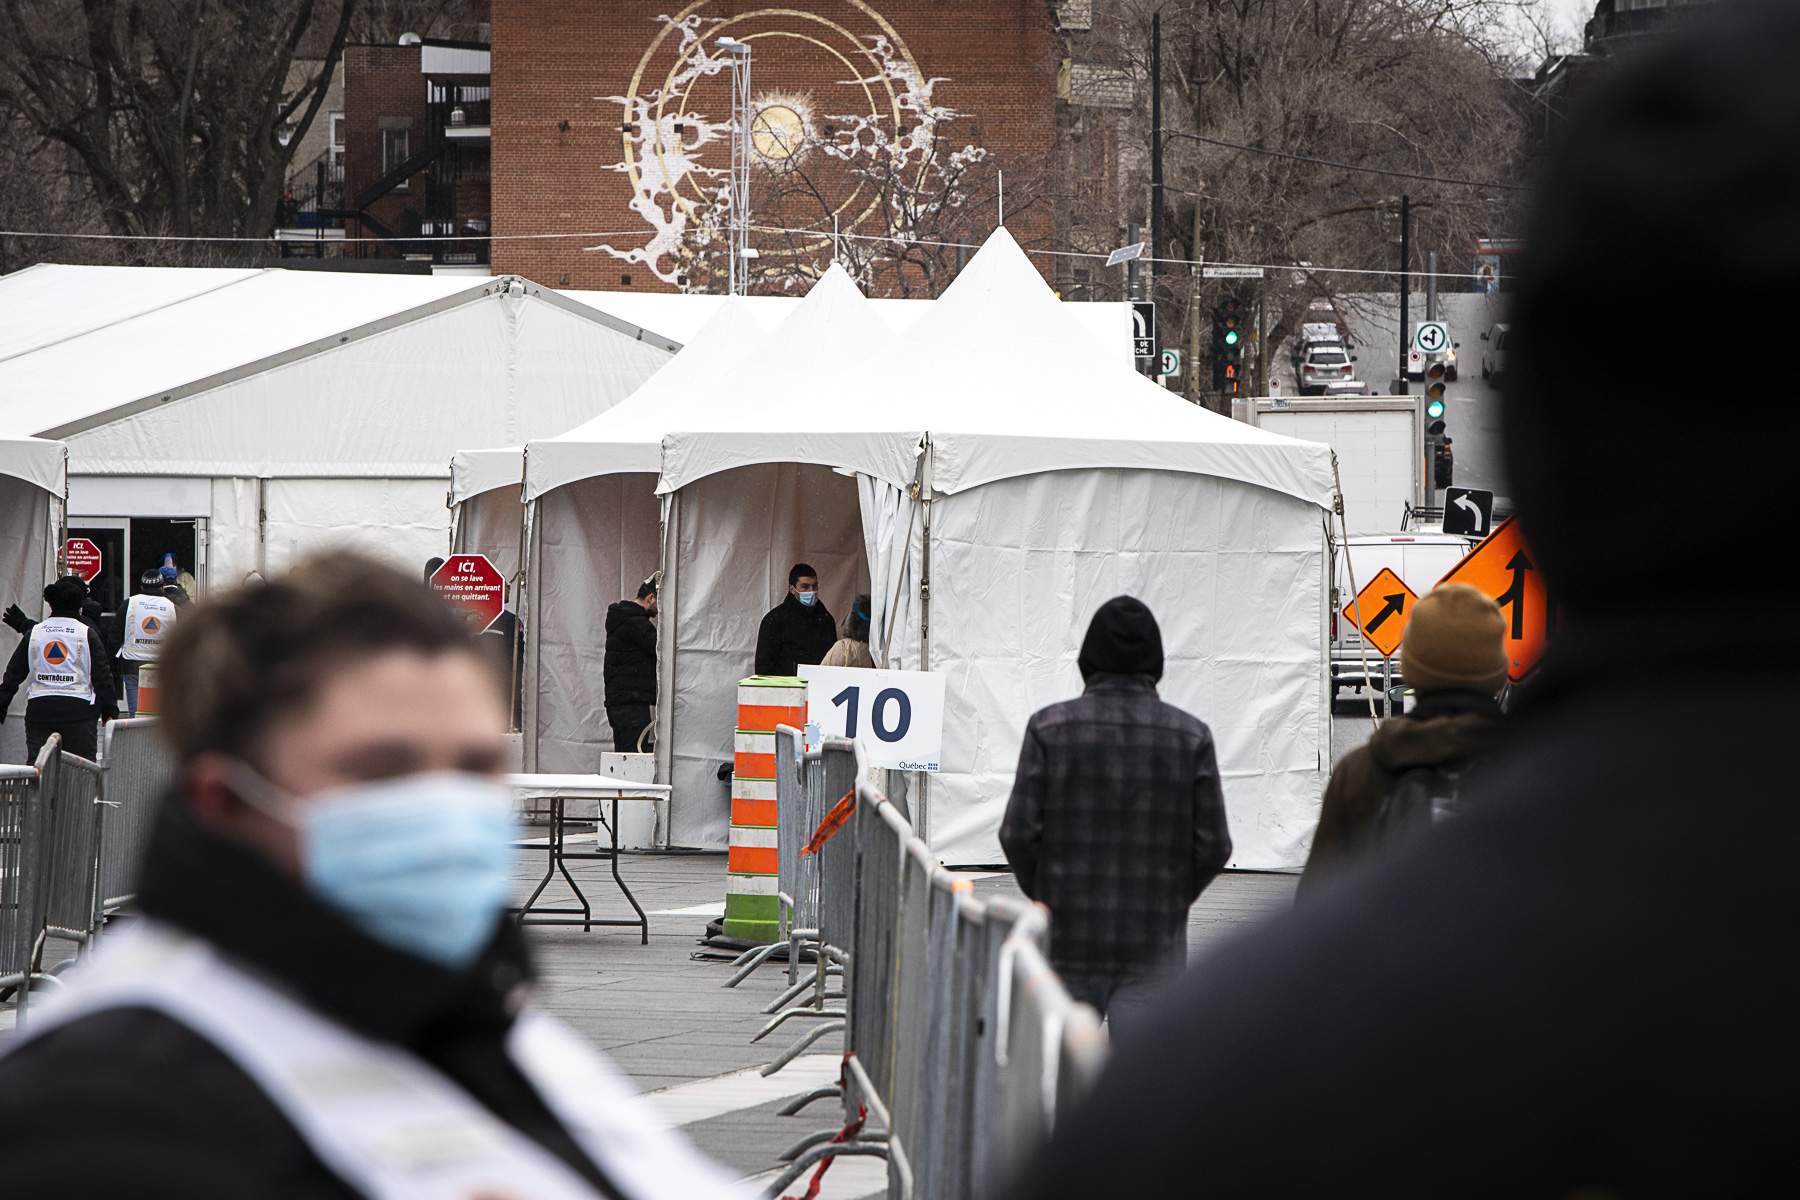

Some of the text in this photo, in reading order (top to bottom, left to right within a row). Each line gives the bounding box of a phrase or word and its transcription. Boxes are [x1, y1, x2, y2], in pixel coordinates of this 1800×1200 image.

[1139, 340, 1149, 348] DE
[1135, 347, 1148, 355] CHE
[461, 593, 490, 601] quittant.
[37, 674, 75, 682] CONTRÔLEUR
[831, 686, 912, 743] 10
[899, 761, 927, 770] Québec
